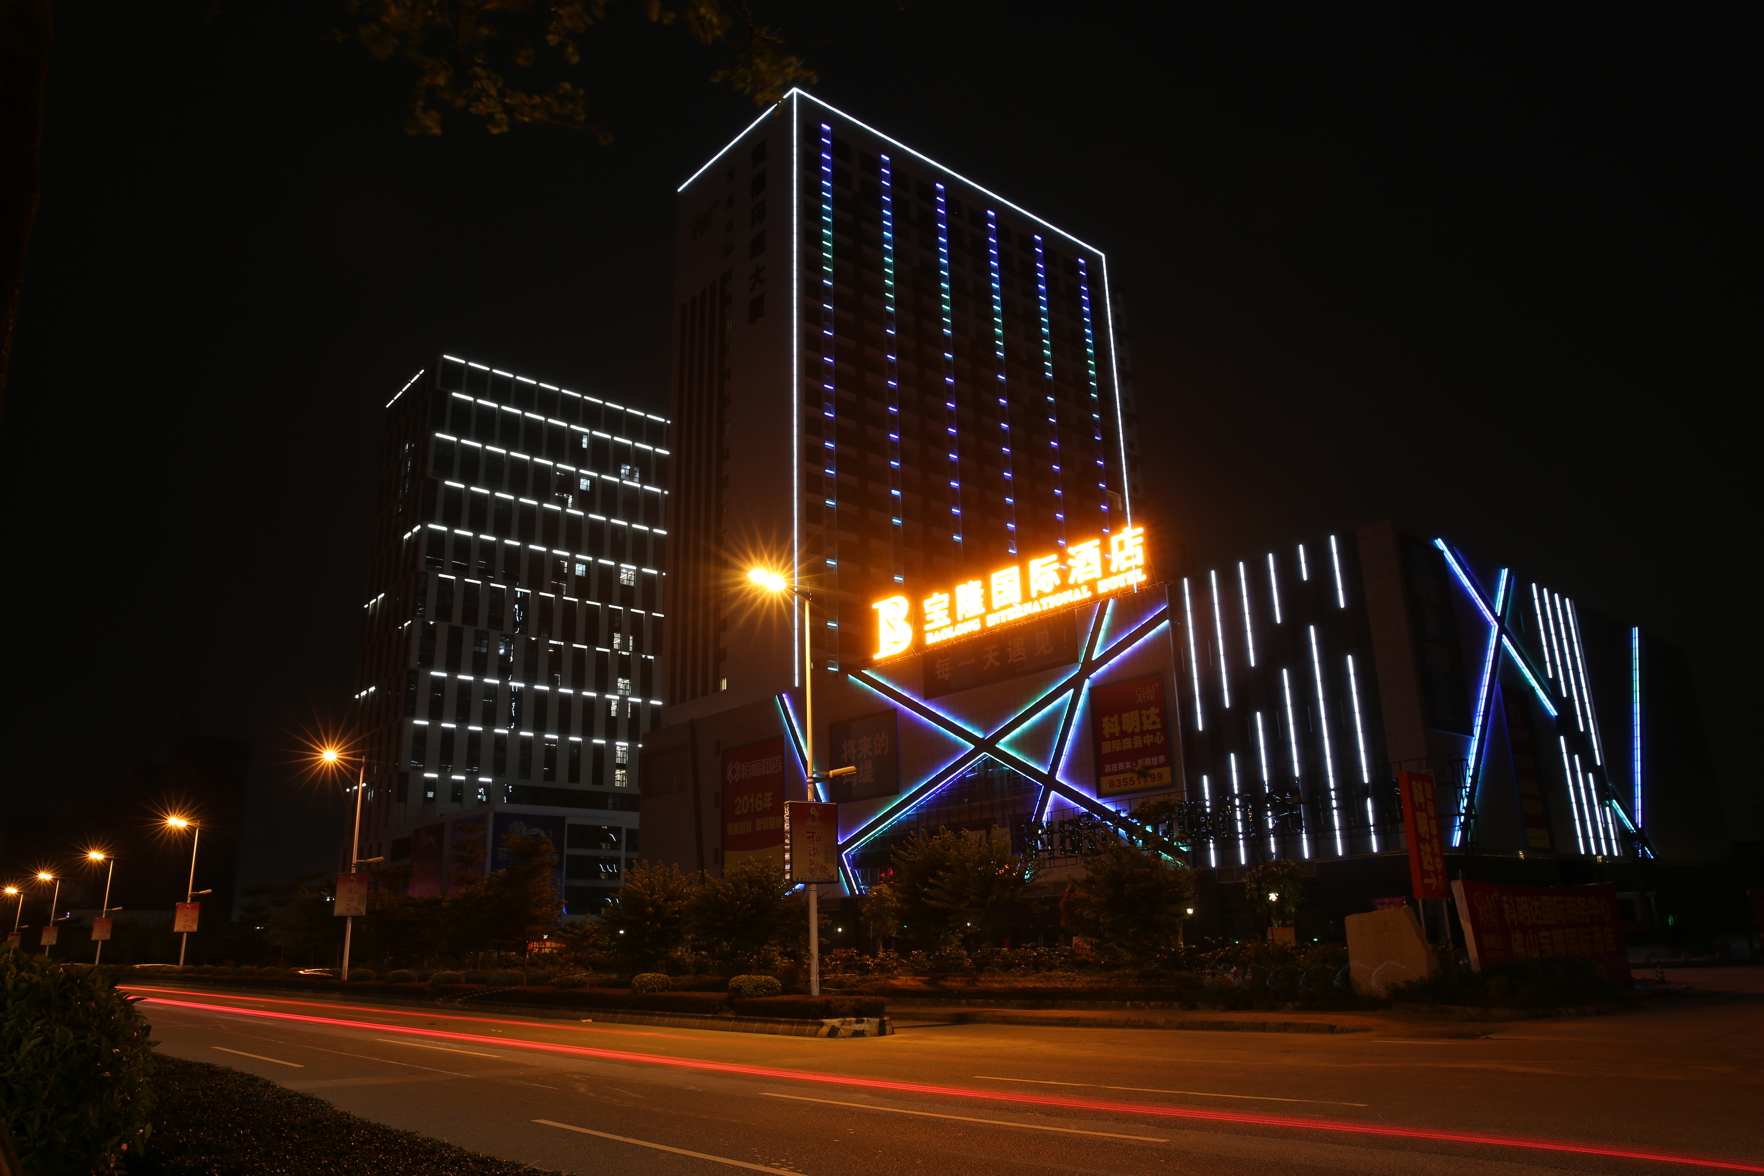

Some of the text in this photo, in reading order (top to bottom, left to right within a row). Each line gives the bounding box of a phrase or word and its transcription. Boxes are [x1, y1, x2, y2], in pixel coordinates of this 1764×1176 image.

[923, 526, 1146, 631] 宝隆国际酒店
[925, 570, 1147, 645] BAOLONG INTERNATIONAL HOTEL
[1102, 706, 1162, 738] 科明达
[841, 731, 889, 762] 将来的
[1101, 731, 1165, 754] 国际商务中心
[740, 756, 783, 779] 恒福陶瓷
[734, 791, 773, 816] 2016年
[1411, 780, 1434, 871] 科明达
[1424, 782, 1445, 892] 国际商务中心
[1501, 894, 1611, 927] 科明达国际商务中心
[1511, 926, 1617, 960] 佛山宝隆国际酒店
